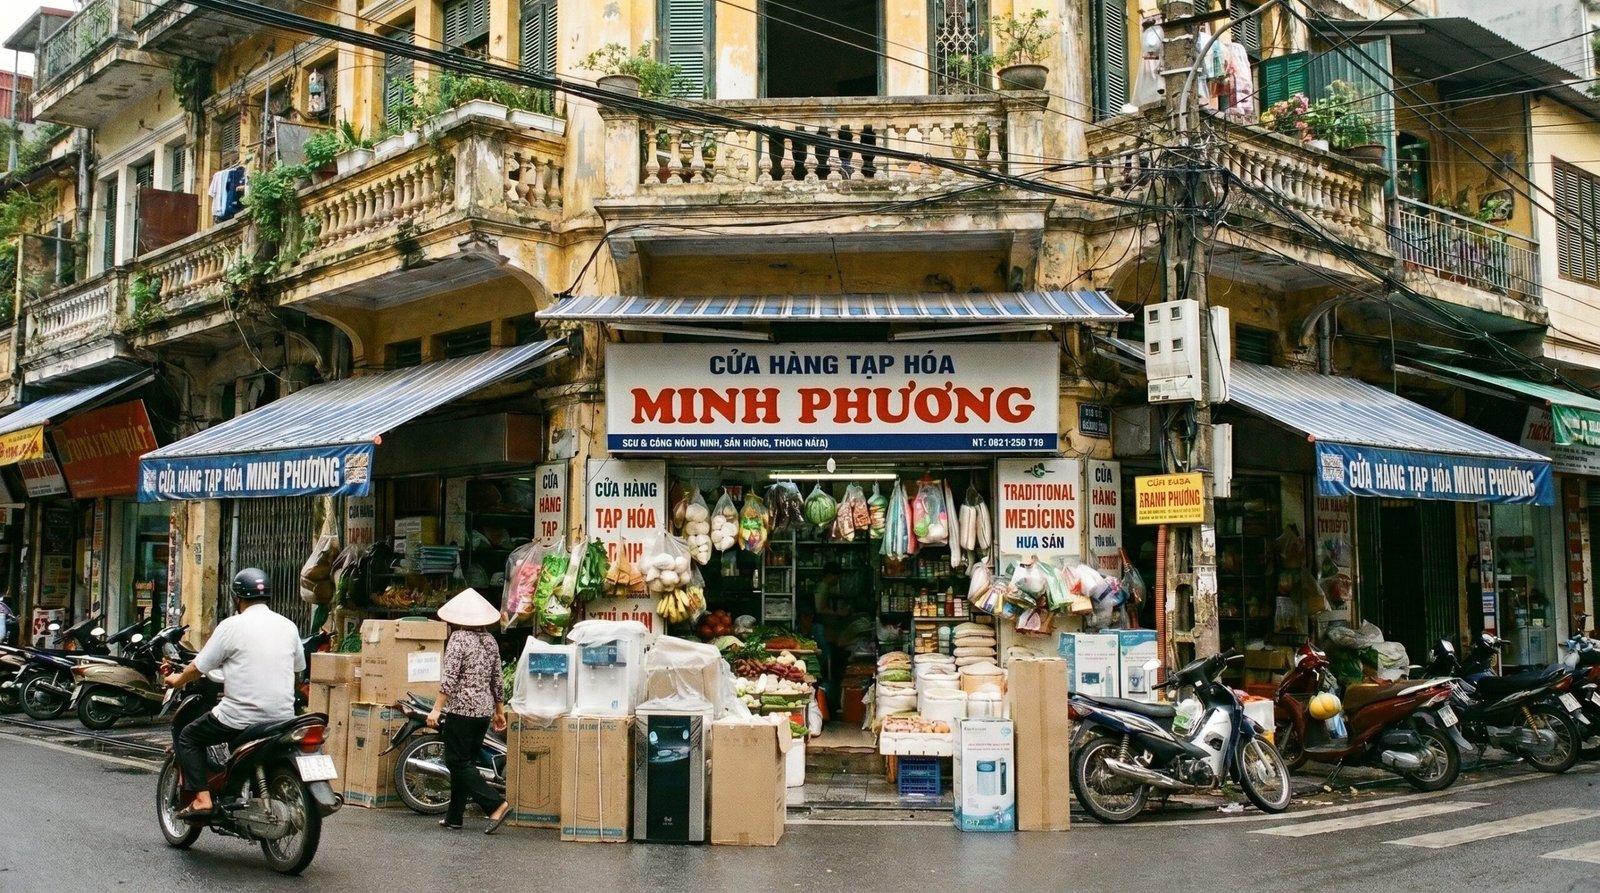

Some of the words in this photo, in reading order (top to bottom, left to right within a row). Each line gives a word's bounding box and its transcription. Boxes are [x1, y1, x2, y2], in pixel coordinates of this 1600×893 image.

[710, 348, 760, 375] CỬA
[769, 351, 839, 375] HÀNG
[847, 355, 895, 379] TẠP
[904, 350, 955, 374] HÓA
[630, 387, 781, 424] MINH
[797, 380, 1035, 424] PHƯƠNG
[158, 463, 176, 493] CỬA
[177, 465, 201, 493] HÀNG
[204, 469, 222, 497] TẠP
[224, 463, 243, 491] HÓA
[246, 461, 280, 491] MINH
[283, 455, 340, 489] PHƯƠNG
[595, 477, 620, 498] CỬA
[624, 478, 657, 498] HÀNG
[1349, 453, 1372, 489] CỬA
[1375, 459, 1406, 491] HÀNG
[1408, 466, 1429, 497] TẠP
[1431, 463, 1452, 493] HÓA
[1453, 465, 1487, 495] MINH
[1488, 466, 1536, 497] PHƯƠNG
[539, 493, 561, 513] HÀNG
[1004, 484, 1075, 500] TRADITIONAL
[1092, 486, 1117, 506] HÀNG
[596, 508, 623, 533] TẠP
[627, 503, 656, 528] HÓA
[542, 521, 558, 541] TẠP
